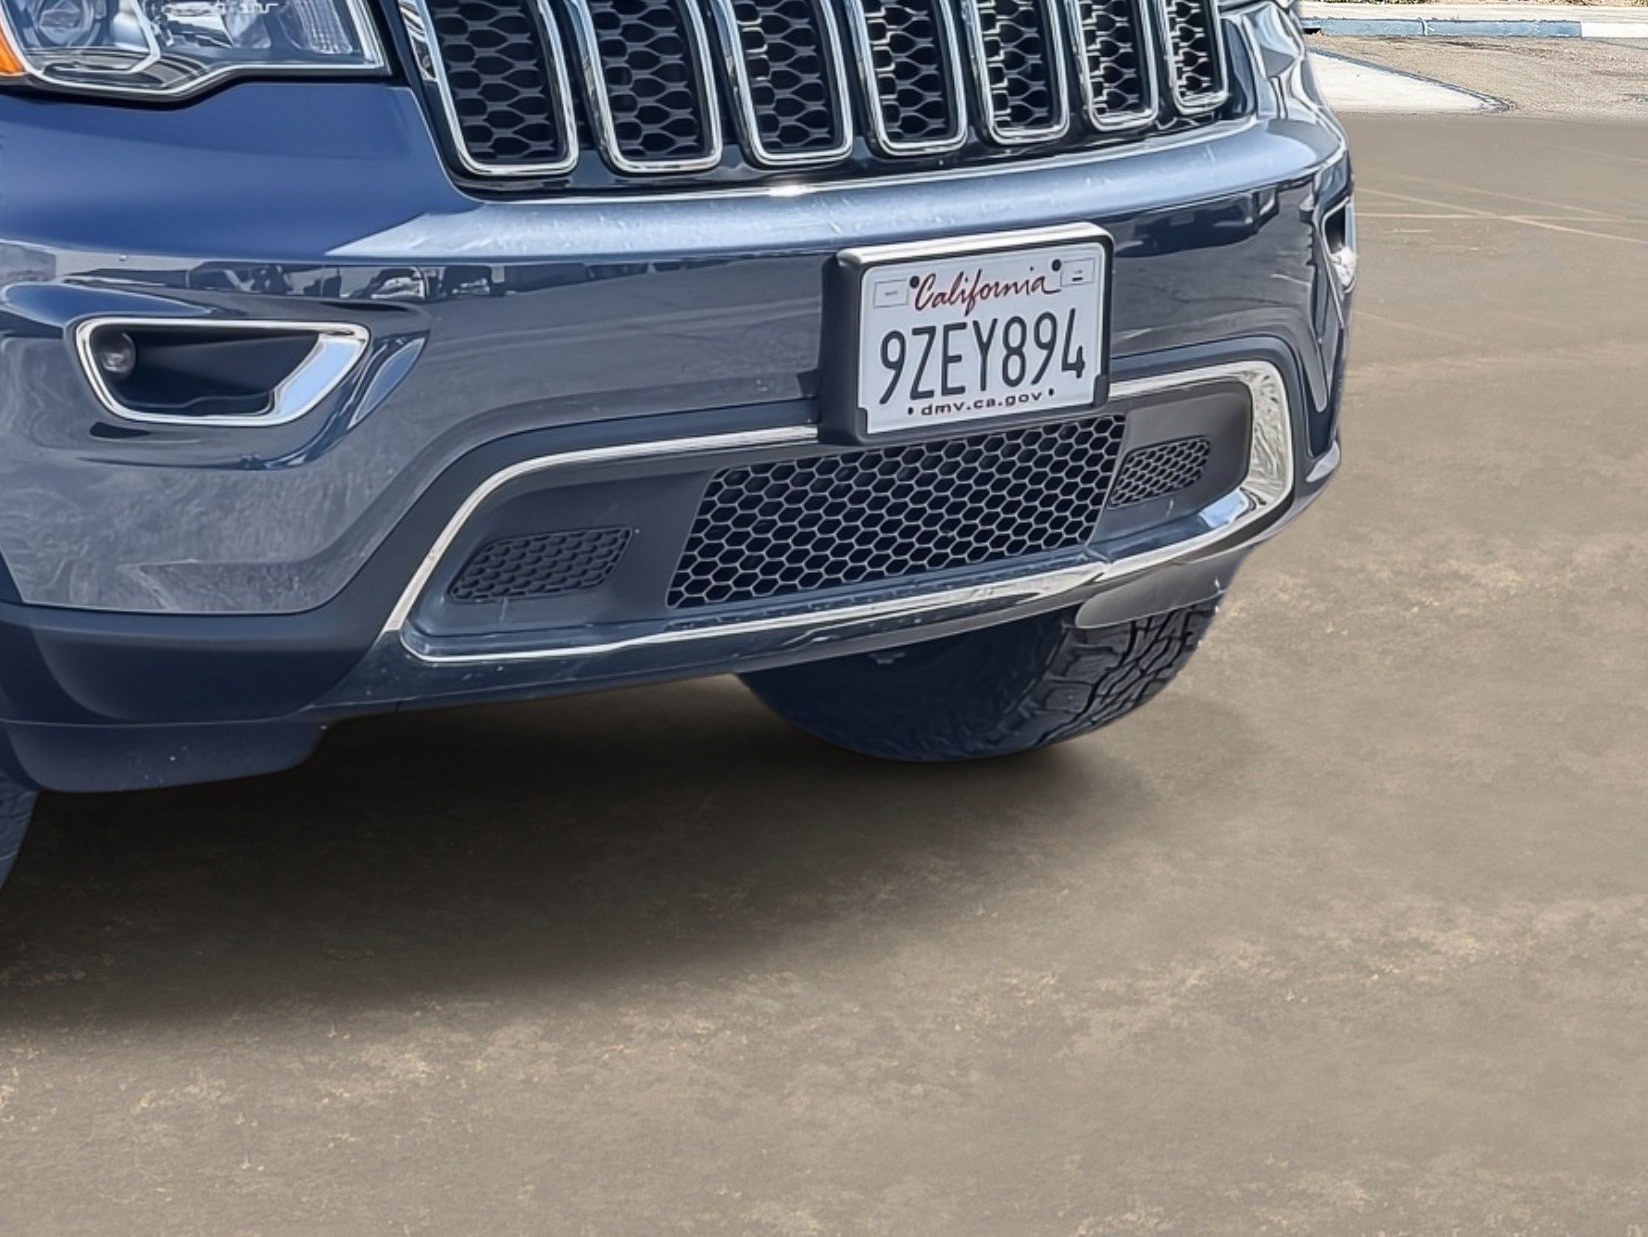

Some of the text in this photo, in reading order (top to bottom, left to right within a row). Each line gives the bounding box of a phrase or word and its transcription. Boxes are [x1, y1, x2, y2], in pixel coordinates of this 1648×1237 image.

[915, 267, 1061, 316] California
[879, 308, 1086, 404] 9ZEY894
[921, 391, 1042, 415] dmv.ca.gov
